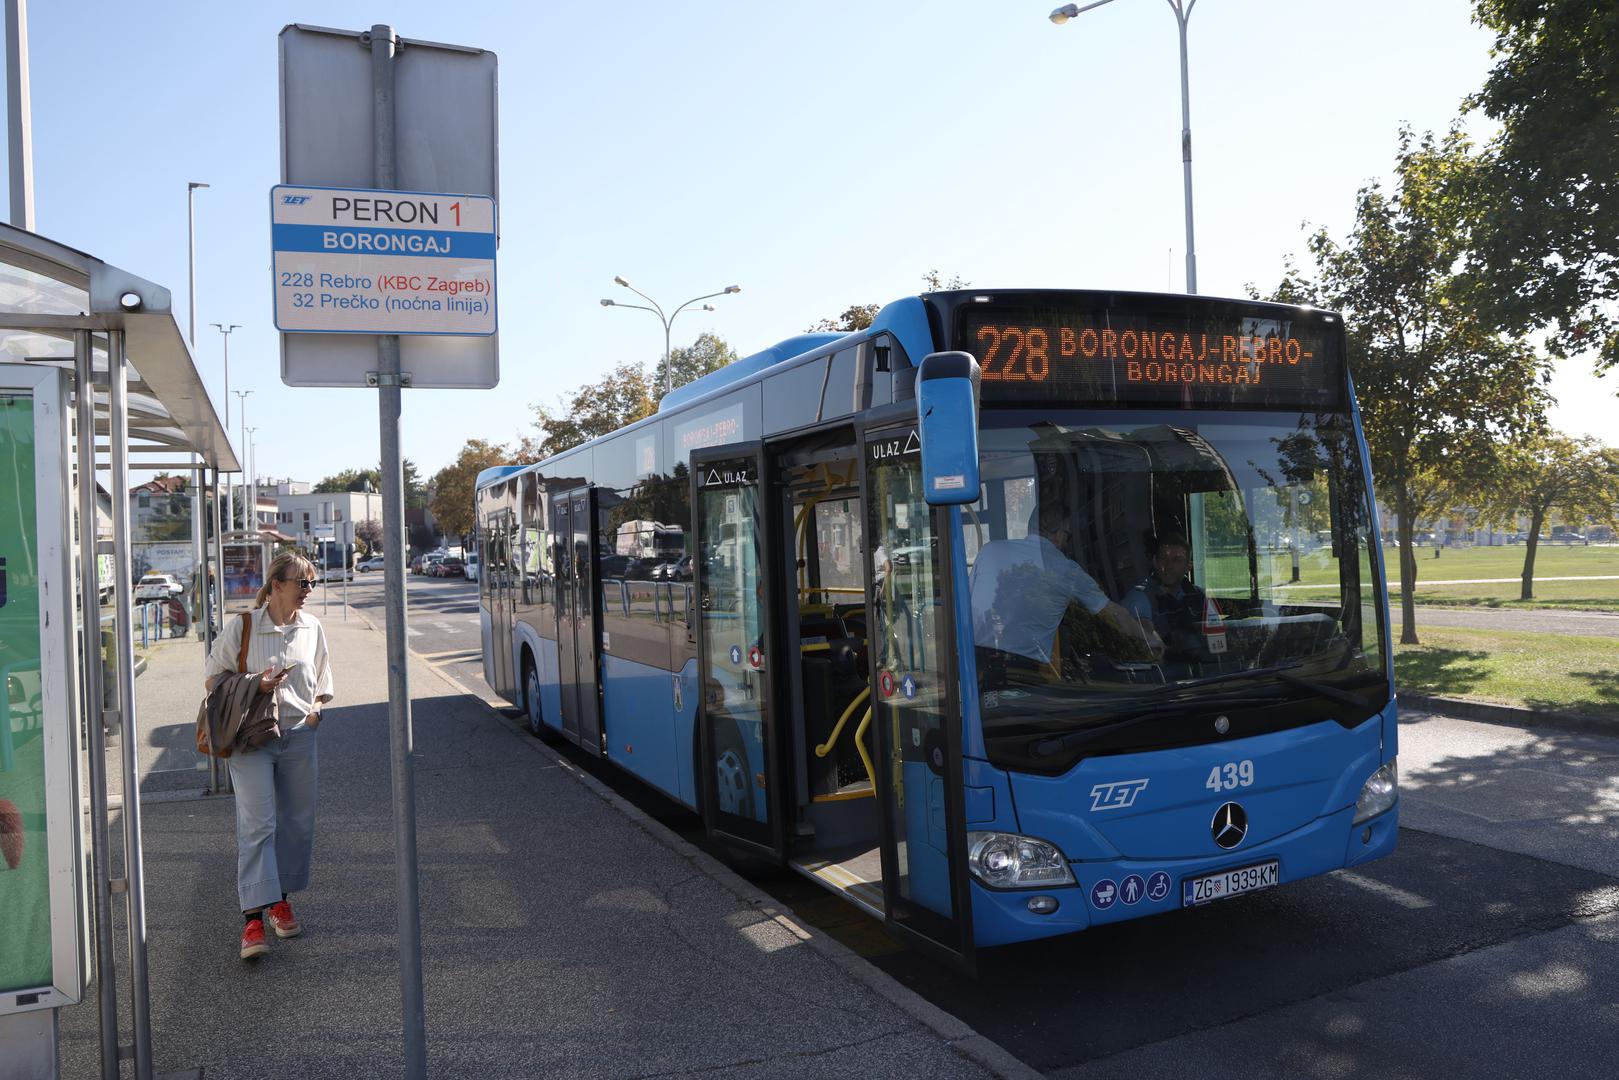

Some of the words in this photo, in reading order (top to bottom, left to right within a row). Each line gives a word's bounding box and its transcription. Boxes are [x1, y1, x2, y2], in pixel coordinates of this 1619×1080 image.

[332, 197, 438, 224] PERON
[450, 201, 461, 226] 1
[323, 231, 451, 253] BORONGAJ
[281, 272, 314, 287] 228
[320, 273, 372, 289] Rebro
[377, 275, 421, 294] (KBC
[427, 277, 491, 297] Zagreb)
[293, 293, 314, 308] 32
[320, 293, 380, 309] Prečko
[385, 297, 441, 313] (noćna
[447, 298, 489, 315] linija)
[976, 325, 1049, 382] 228
[1060, 327, 1313, 366] BORONGAJ-REBRO-
[1127, 361, 1262, 385] BORONGAJ
[873, 441, 900, 459] ULAZ
[724, 470, 747, 484] ULAZ
[1206, 760, 1255, 792] 439
[1089, 778, 1150, 812] ZET
[1195, 879, 1213, 901] ZG
